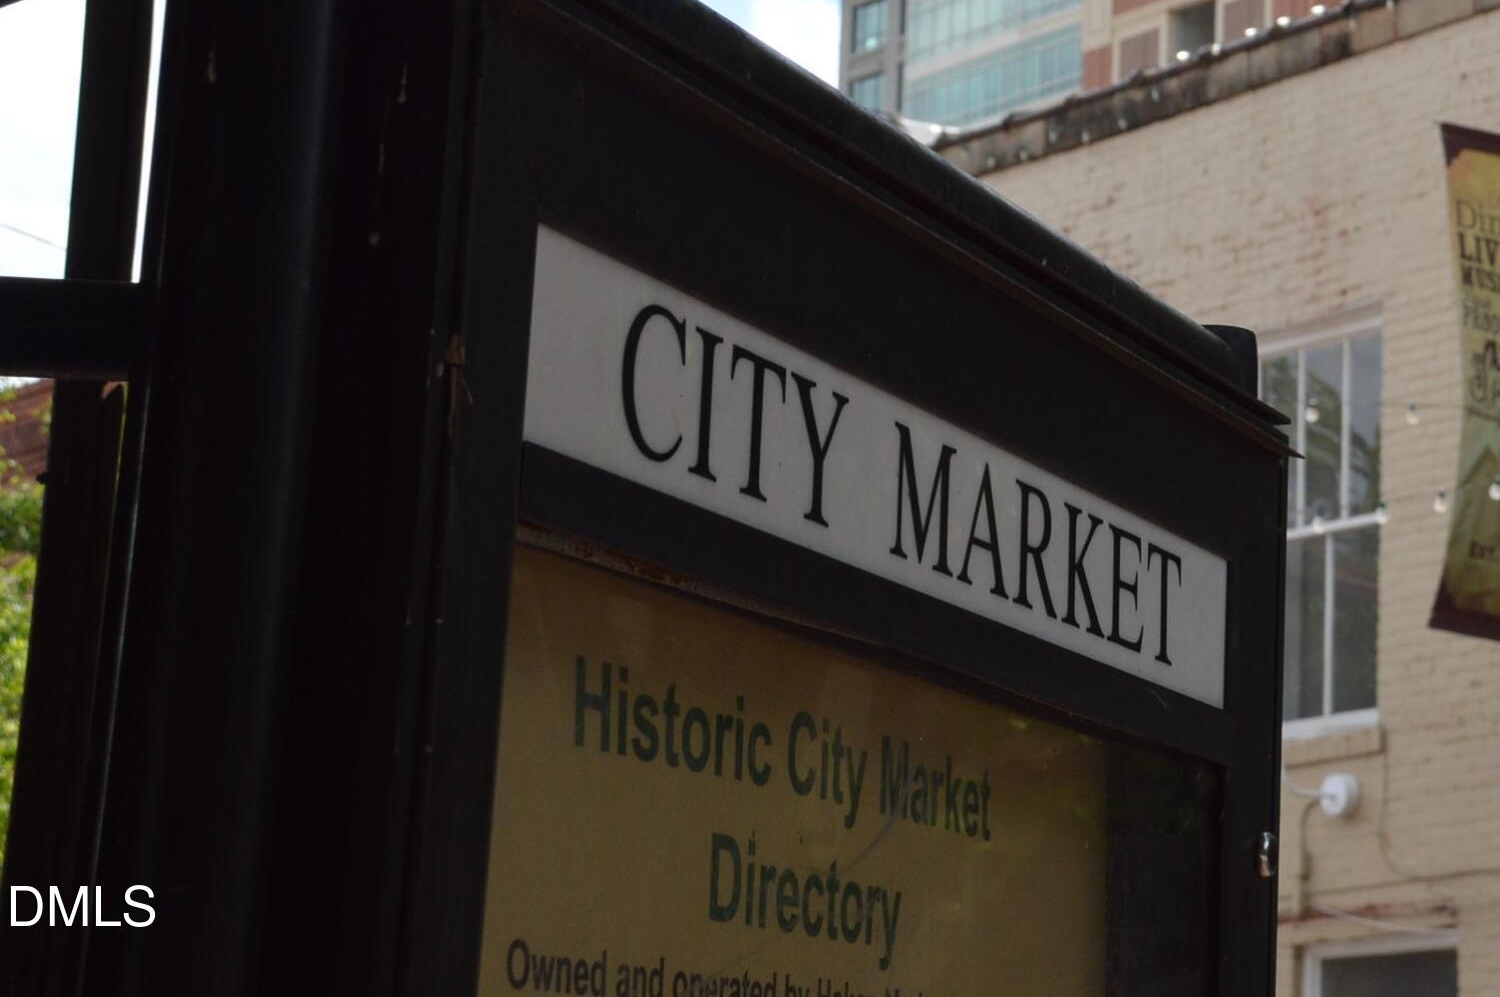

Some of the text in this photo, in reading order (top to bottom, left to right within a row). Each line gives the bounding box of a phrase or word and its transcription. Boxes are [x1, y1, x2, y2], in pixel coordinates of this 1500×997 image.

[620, 304, 1182, 667] CITY MARKET
[574, 655, 991, 841] Historic City Market
[506, 938, 608, 997] Owned
[616, 956, 666, 997] and
[672, 969, 778, 997] operated
[709, 831, 902, 971] Directory
